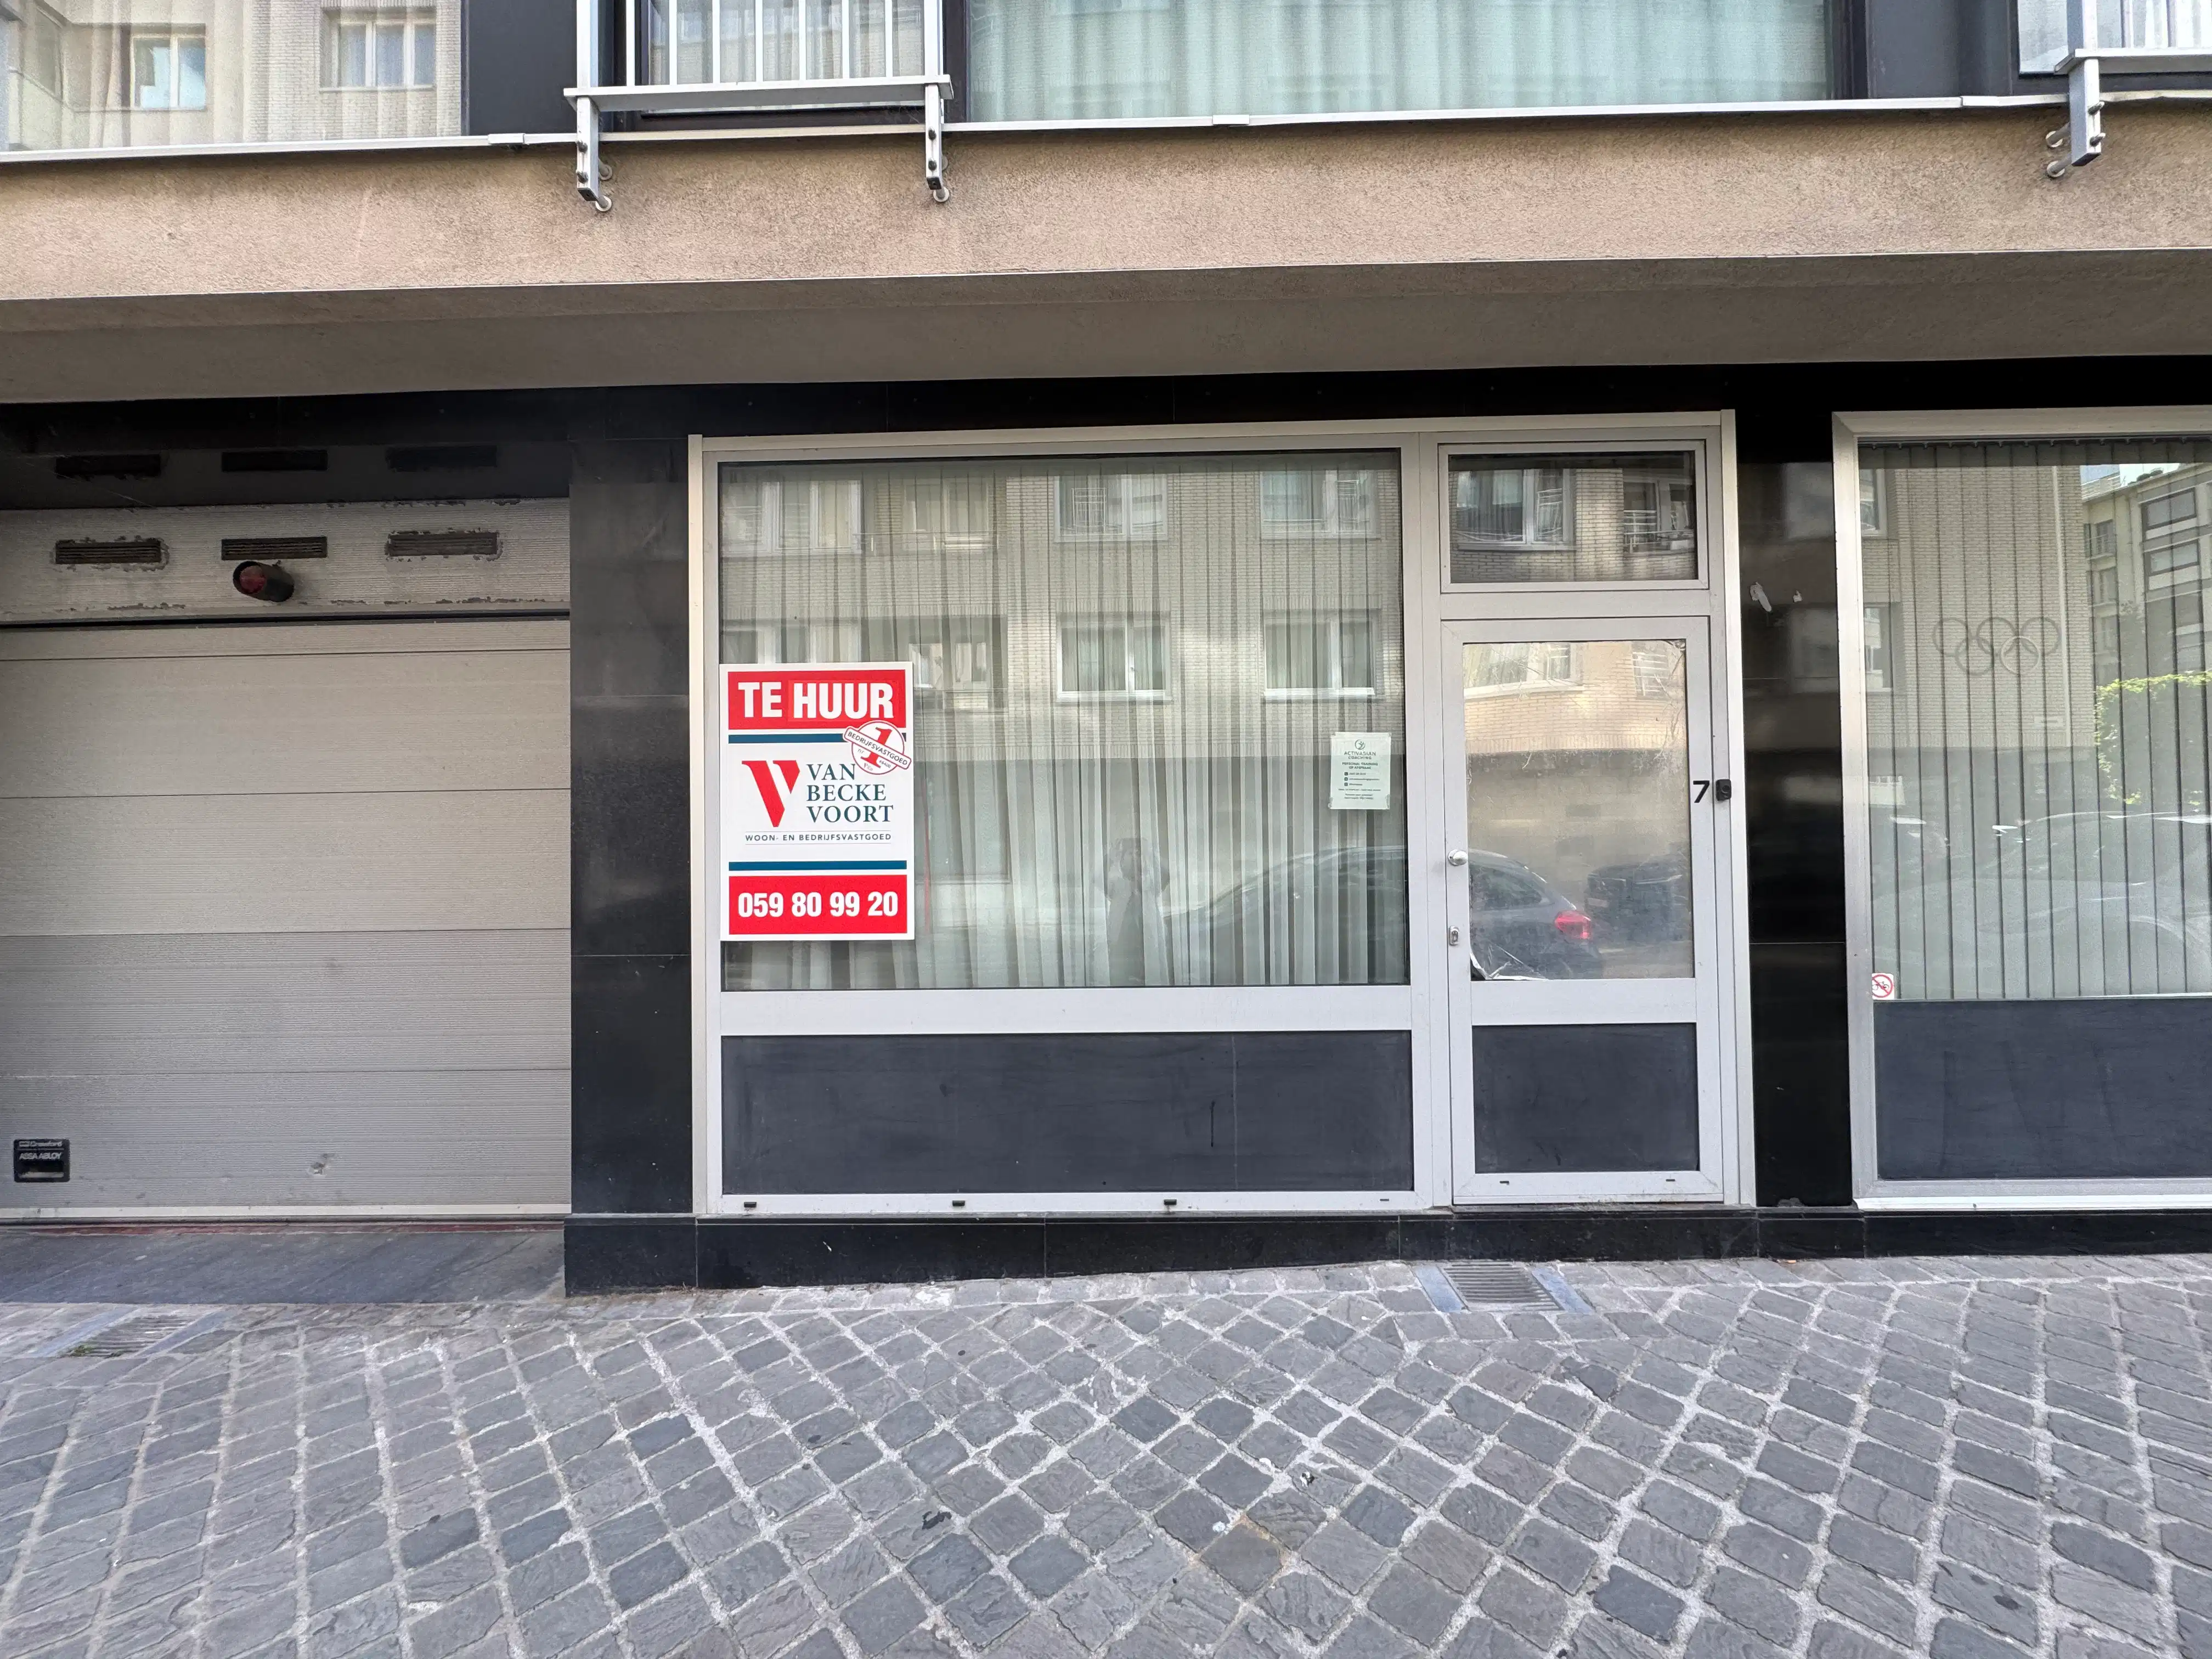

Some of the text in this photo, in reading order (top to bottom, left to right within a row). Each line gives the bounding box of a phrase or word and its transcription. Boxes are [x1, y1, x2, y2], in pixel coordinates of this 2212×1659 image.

[738, 681, 893, 719] TE HUUR
[847, 731, 908, 765] BEDRIJFSVASTGOED
[807, 764, 855, 781] VAN
[806, 784, 887, 802] BECKE
[1693, 780, 1709, 803] 7
[806, 805, 894, 823] VOORT
[738, 891, 898, 918] 059 80 99 20
